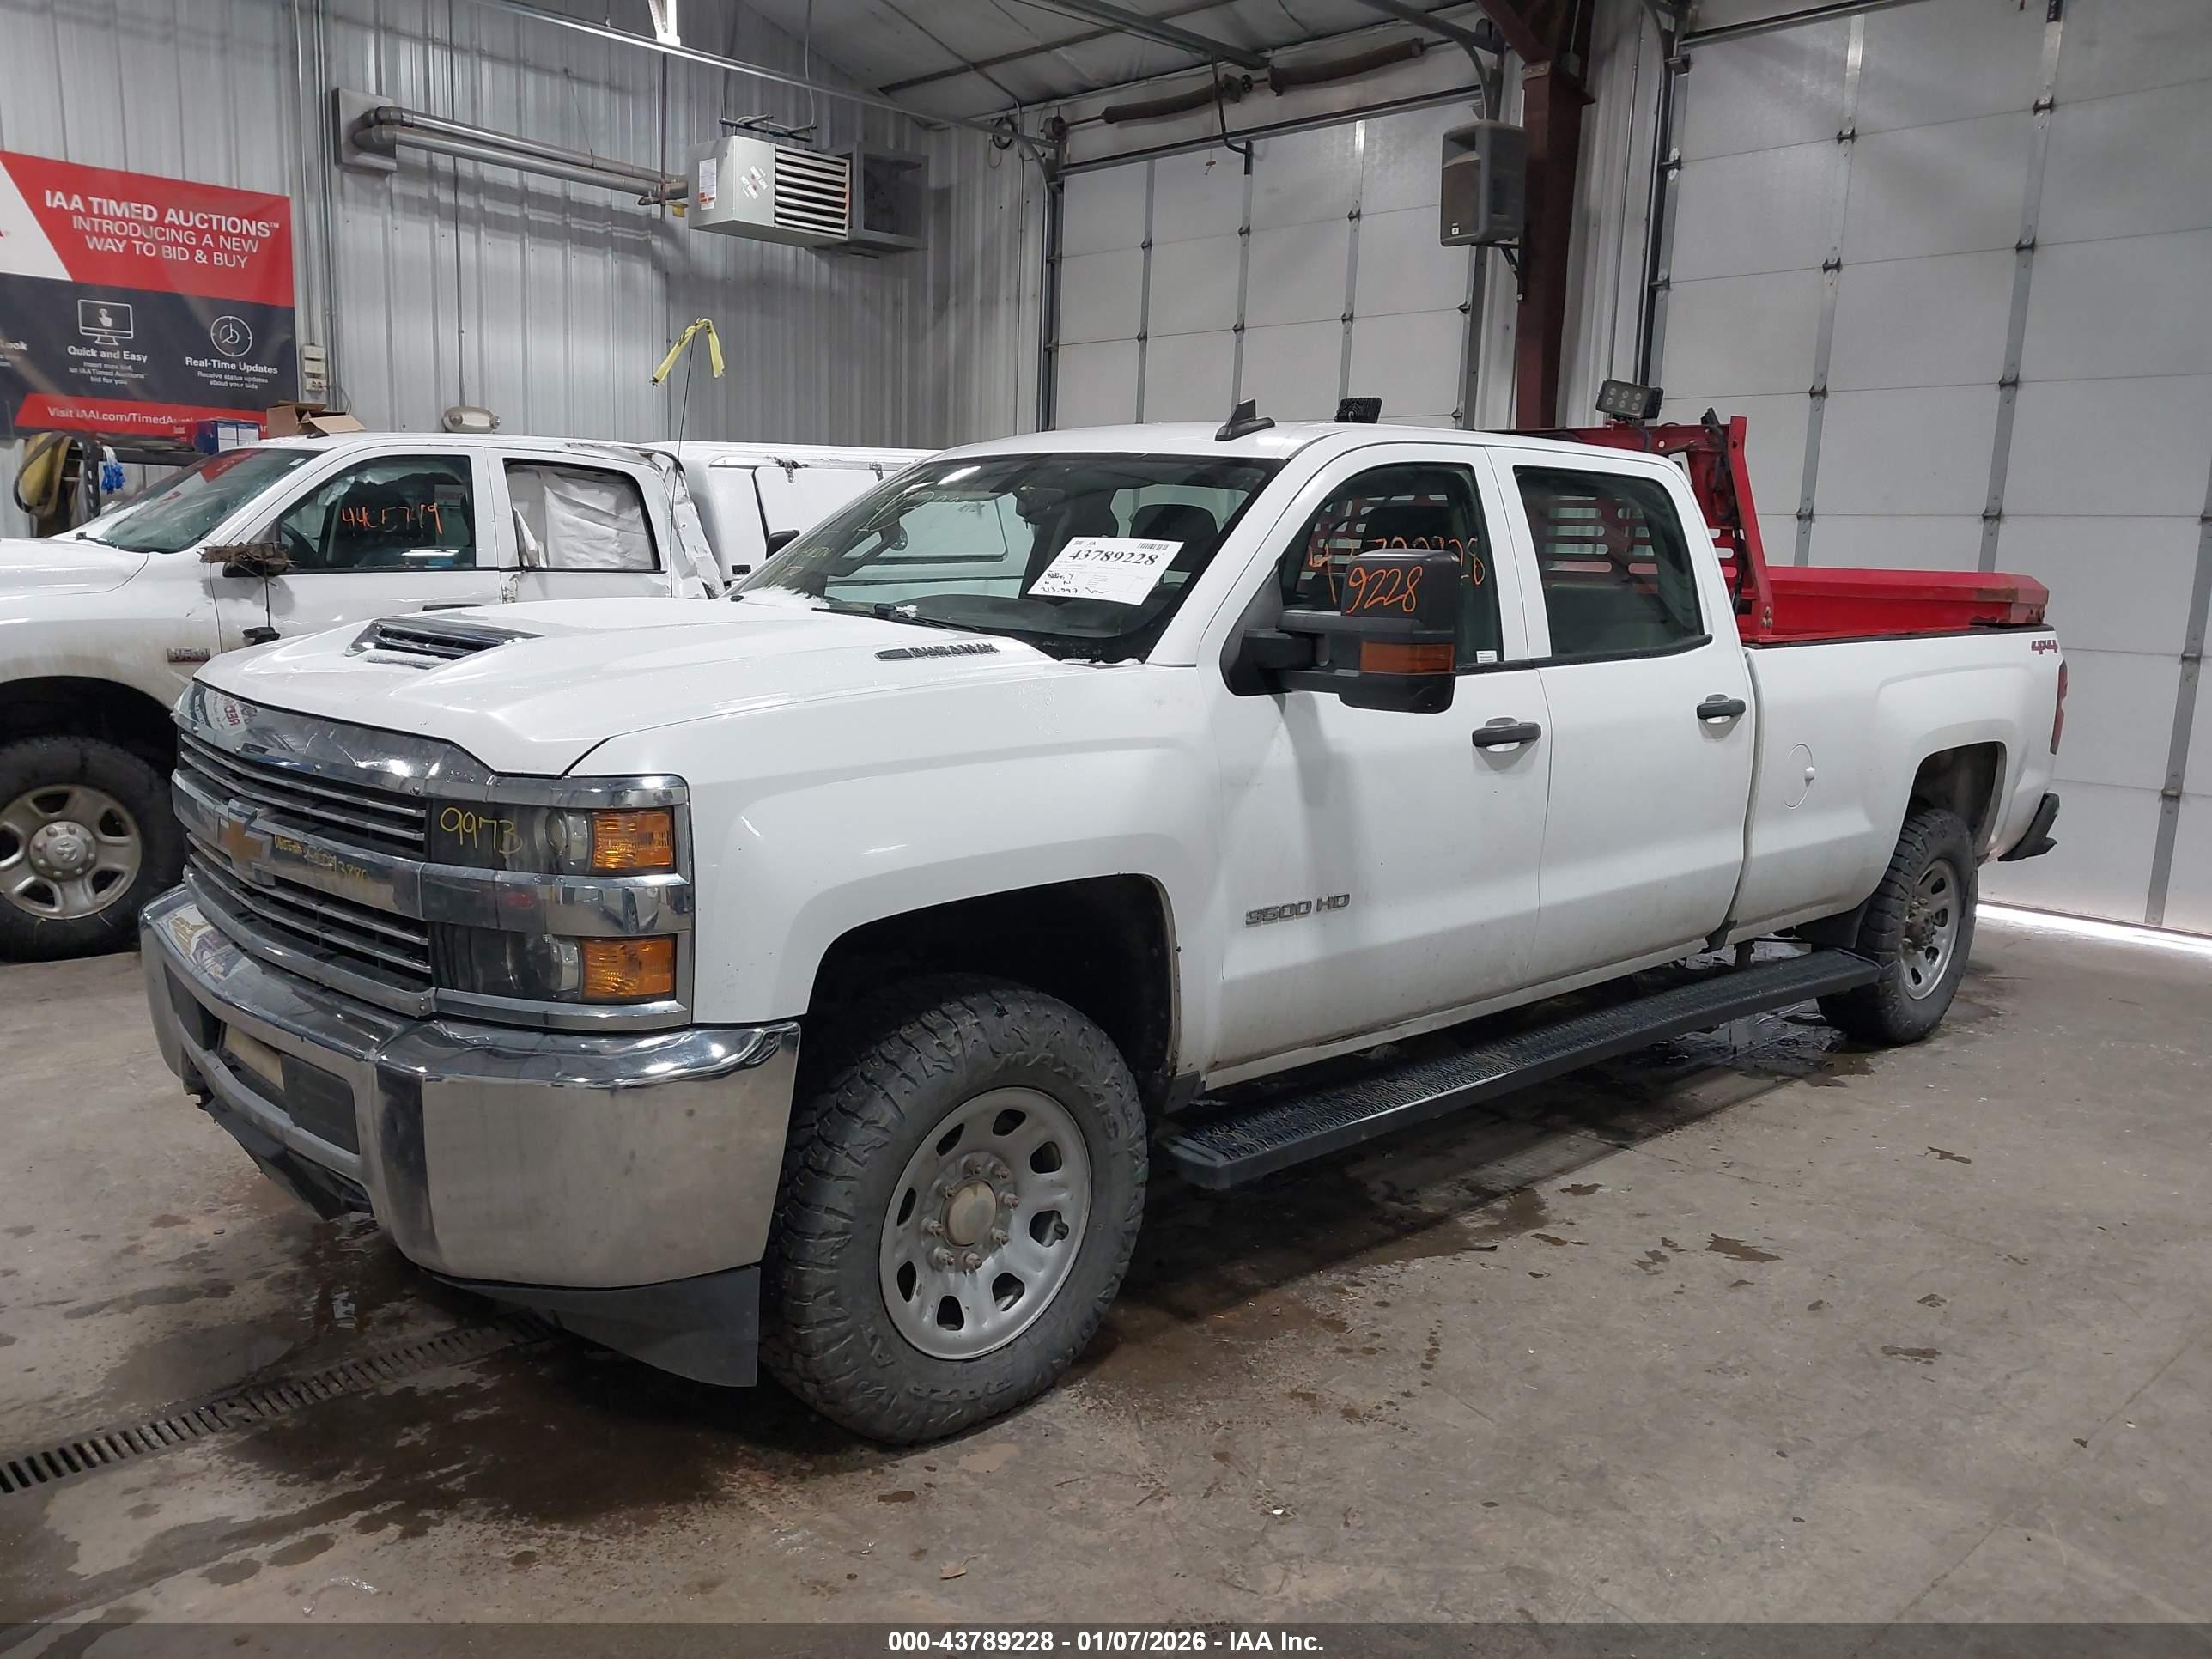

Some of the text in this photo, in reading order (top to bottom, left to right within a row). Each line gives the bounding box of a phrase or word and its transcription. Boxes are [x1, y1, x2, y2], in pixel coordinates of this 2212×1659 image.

[45, 189, 85, 213] IAA
[88, 196, 158, 222] TIMED
[72, 215, 258, 253] INTRODUCING A NEW
[85, 235, 248, 268] WAY TO BID & BUY
[67, 345, 148, 363] Quick and Easy
[185, 356, 278, 374] Real-Time Updates
[47, 406, 74, 418] Visit
[1068, 549, 1159, 566] 43789228
[1346, 565, 1423, 614] 9228
[439, 807, 523, 855] 9973
[1316, 893, 1352, 912] HD
